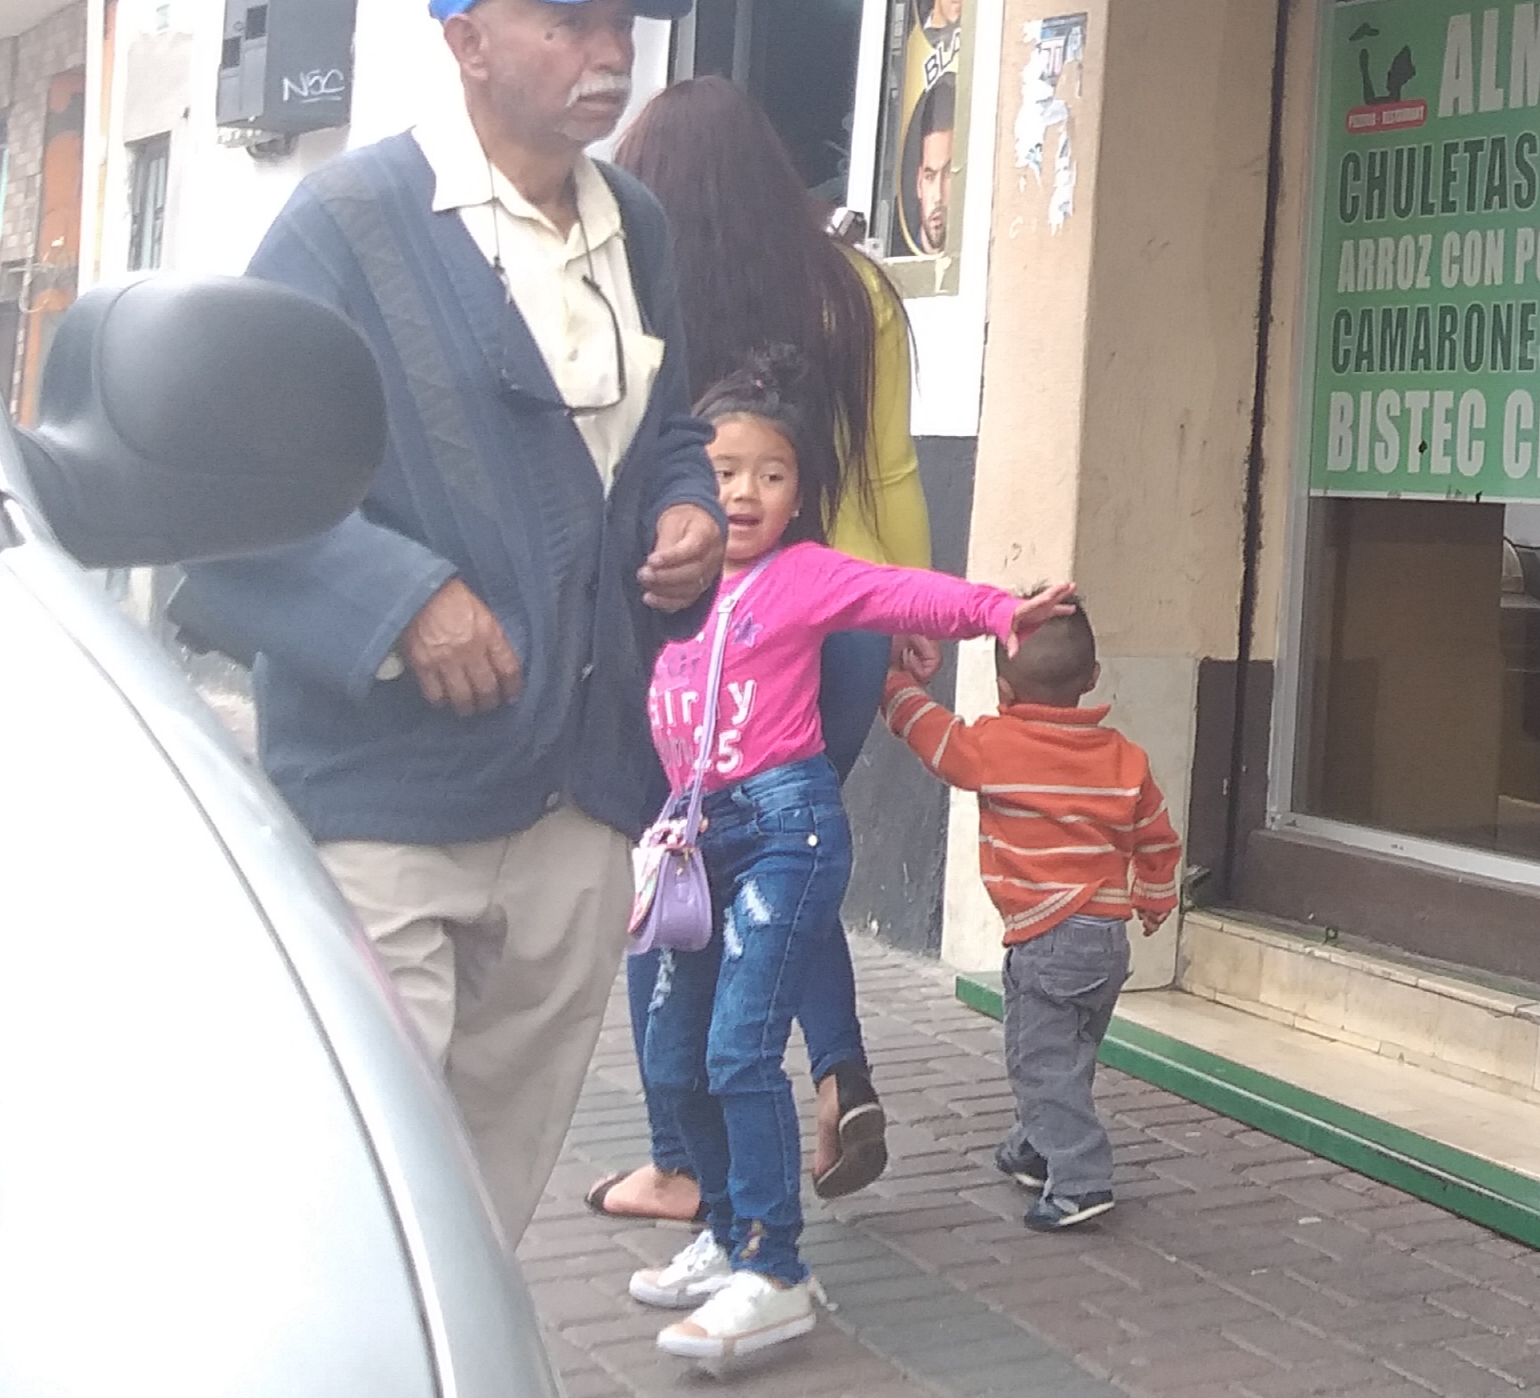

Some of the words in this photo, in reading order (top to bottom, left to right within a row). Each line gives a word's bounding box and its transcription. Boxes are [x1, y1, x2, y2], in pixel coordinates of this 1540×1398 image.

[1340, 131, 1537, 224] CHULETAS
[1337, 234, 1432, 294] ARROZ
[1441, 227, 1503, 287] CON
[1327, 388, 1486, 475] BISTEC
